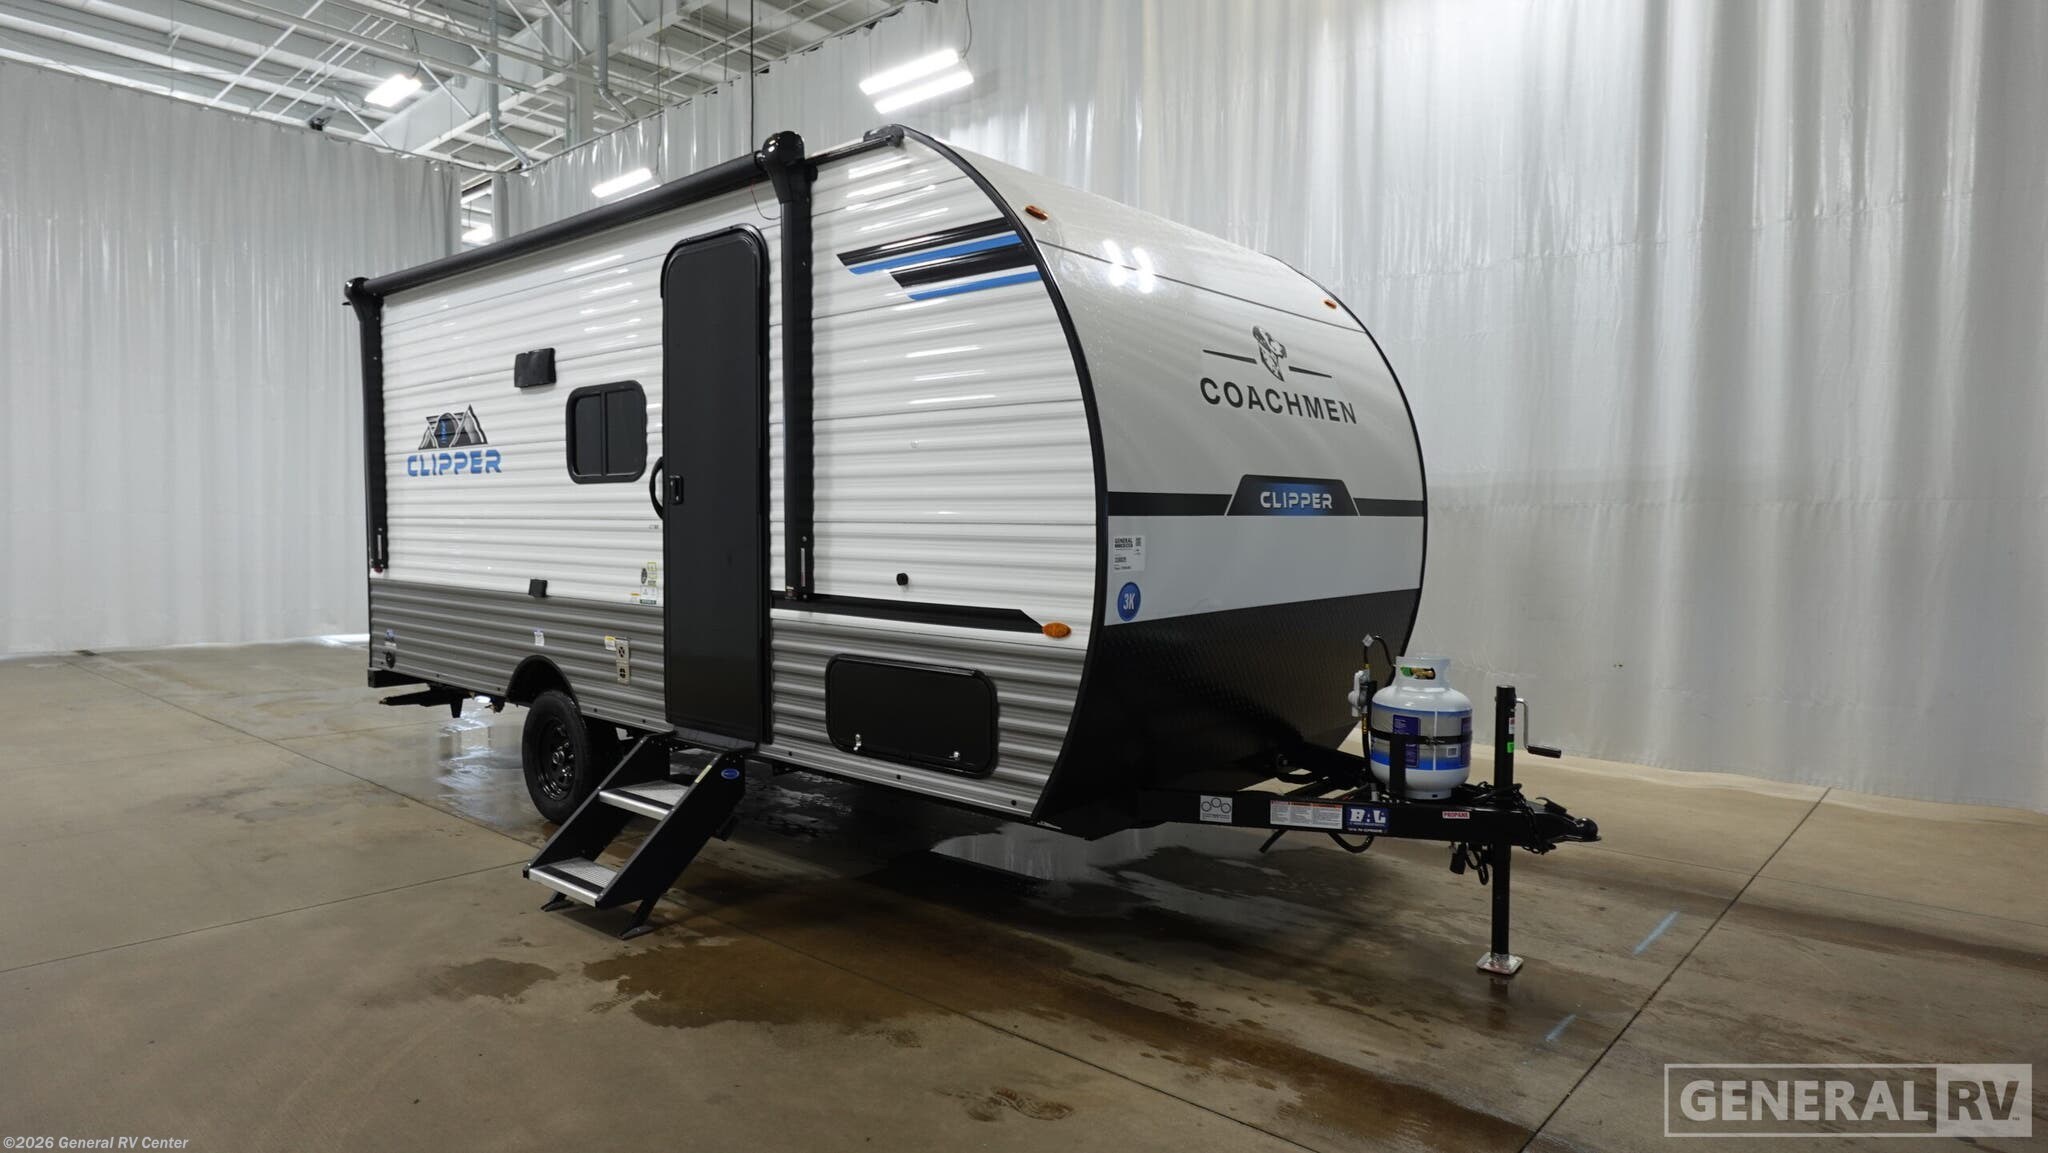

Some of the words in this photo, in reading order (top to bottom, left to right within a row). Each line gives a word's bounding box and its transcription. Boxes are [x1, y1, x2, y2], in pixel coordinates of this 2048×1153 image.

[1200, 377, 1357, 424] COACHMEN
[407, 449, 502, 477] CLIPPER
[1260, 491, 1333, 509] CLIPPER
[1123, 592, 1136, 610] 3K
